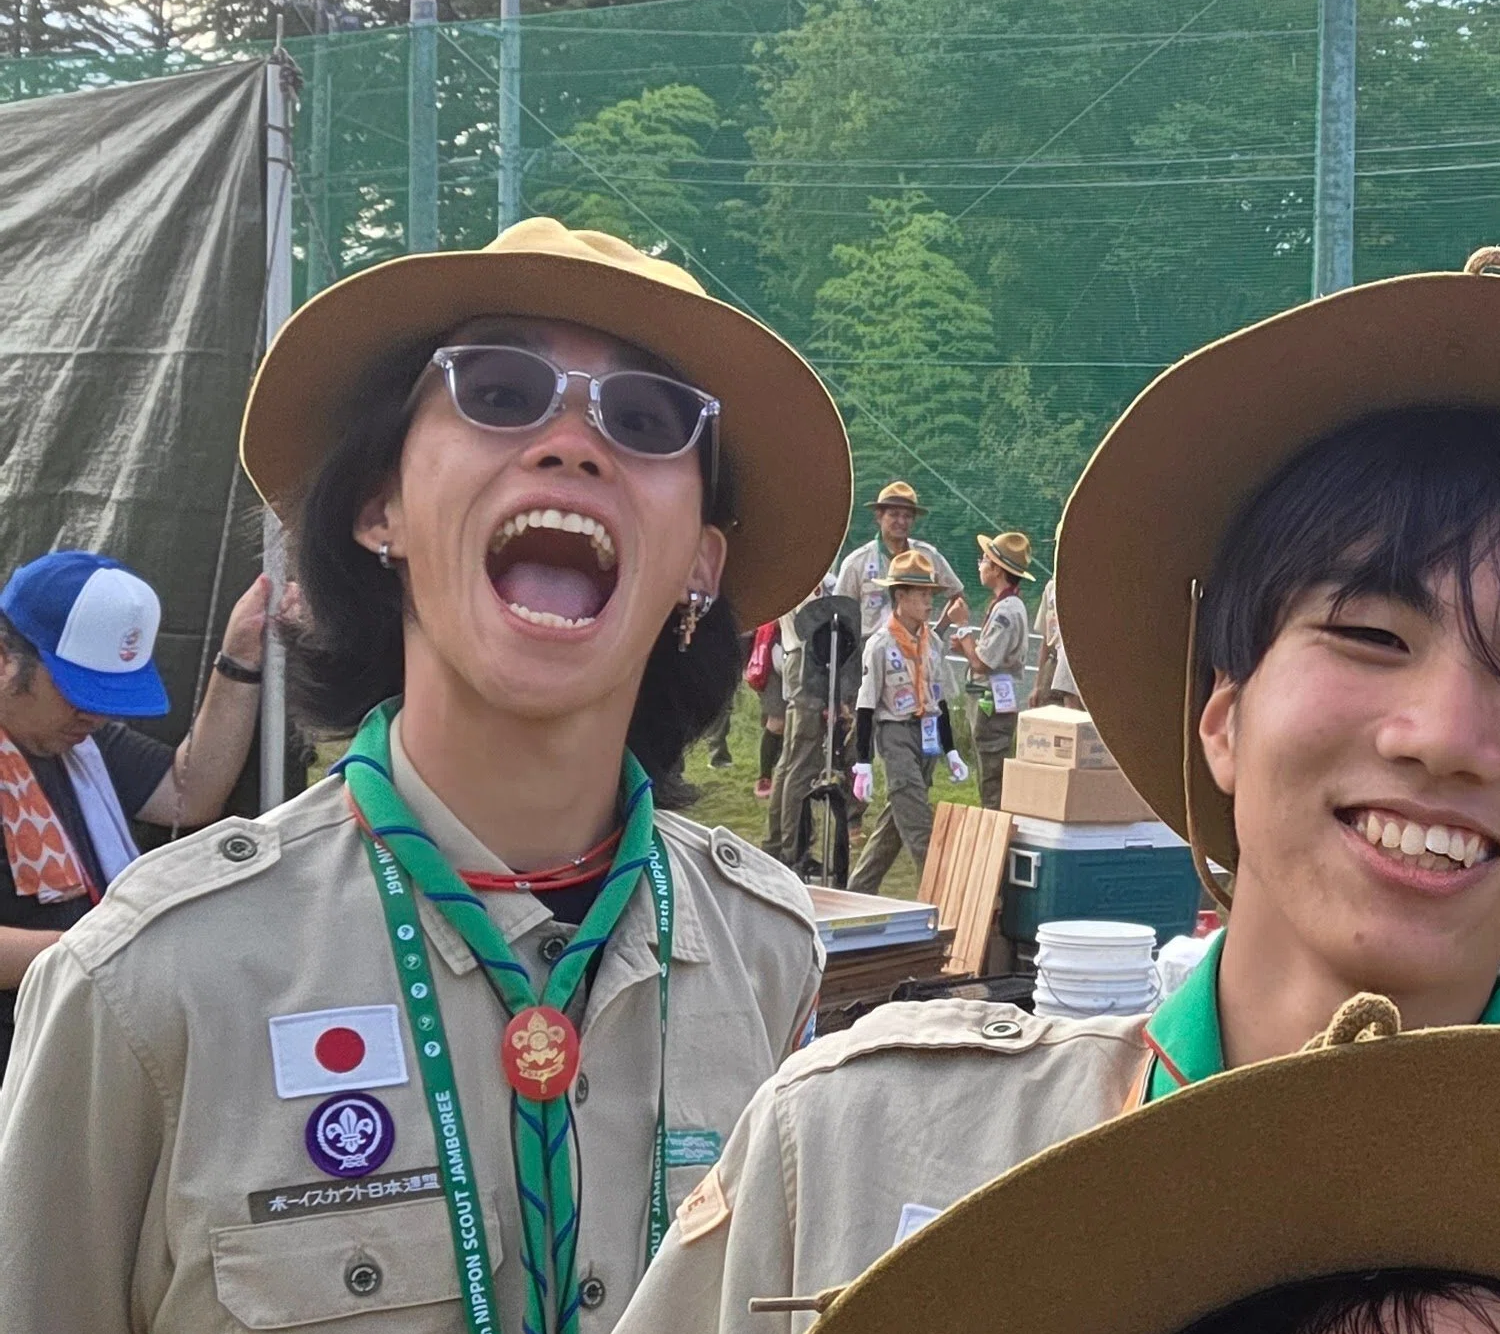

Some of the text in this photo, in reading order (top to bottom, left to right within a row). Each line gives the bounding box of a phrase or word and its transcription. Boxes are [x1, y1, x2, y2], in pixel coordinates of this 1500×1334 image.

[383, 865, 404, 895] 19th
[435, 1089, 467, 1185] JAMBOREE
[268, 1172, 441, 1212] ボーイスカウト日本連盟
[454, 1189, 479, 1251] SCOUT
[466, 1253, 491, 1325] NIPPON
